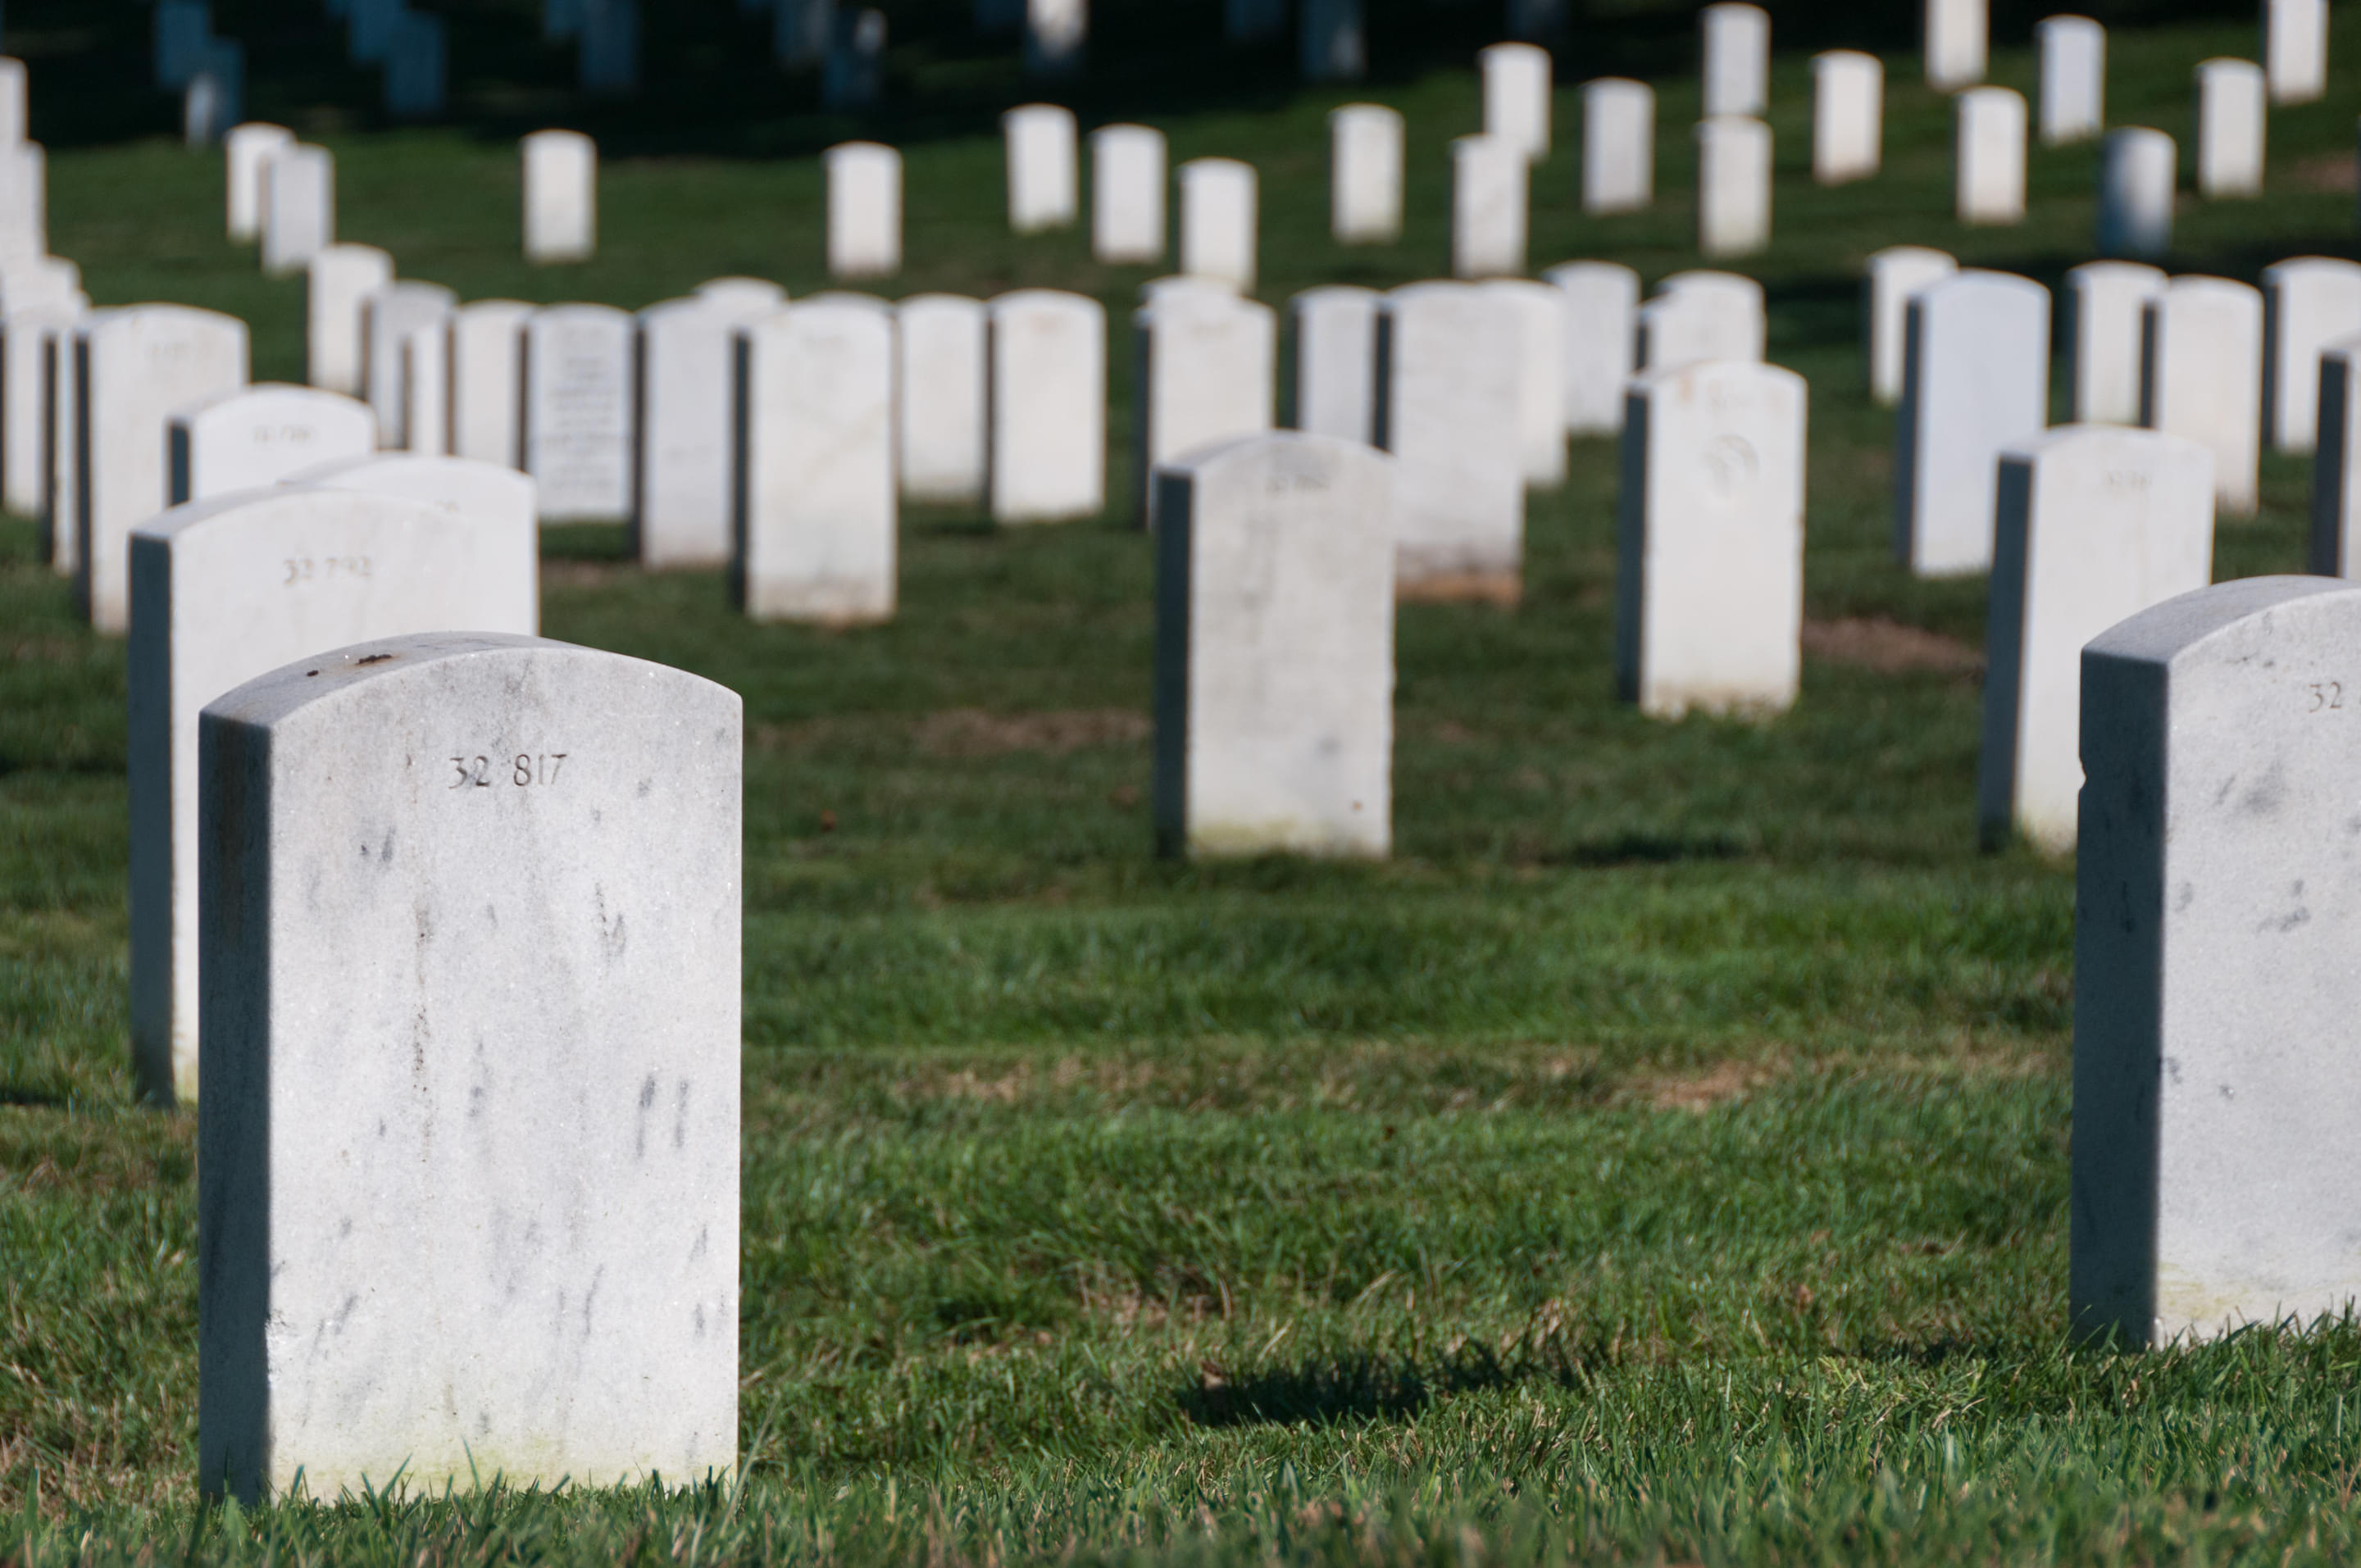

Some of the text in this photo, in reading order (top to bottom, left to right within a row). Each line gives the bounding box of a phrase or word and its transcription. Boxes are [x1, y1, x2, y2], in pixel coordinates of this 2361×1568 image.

[283, 557, 312, 587] 32
[2308, 680, 2342, 713] 32
[448, 753, 567, 789] 32 817
